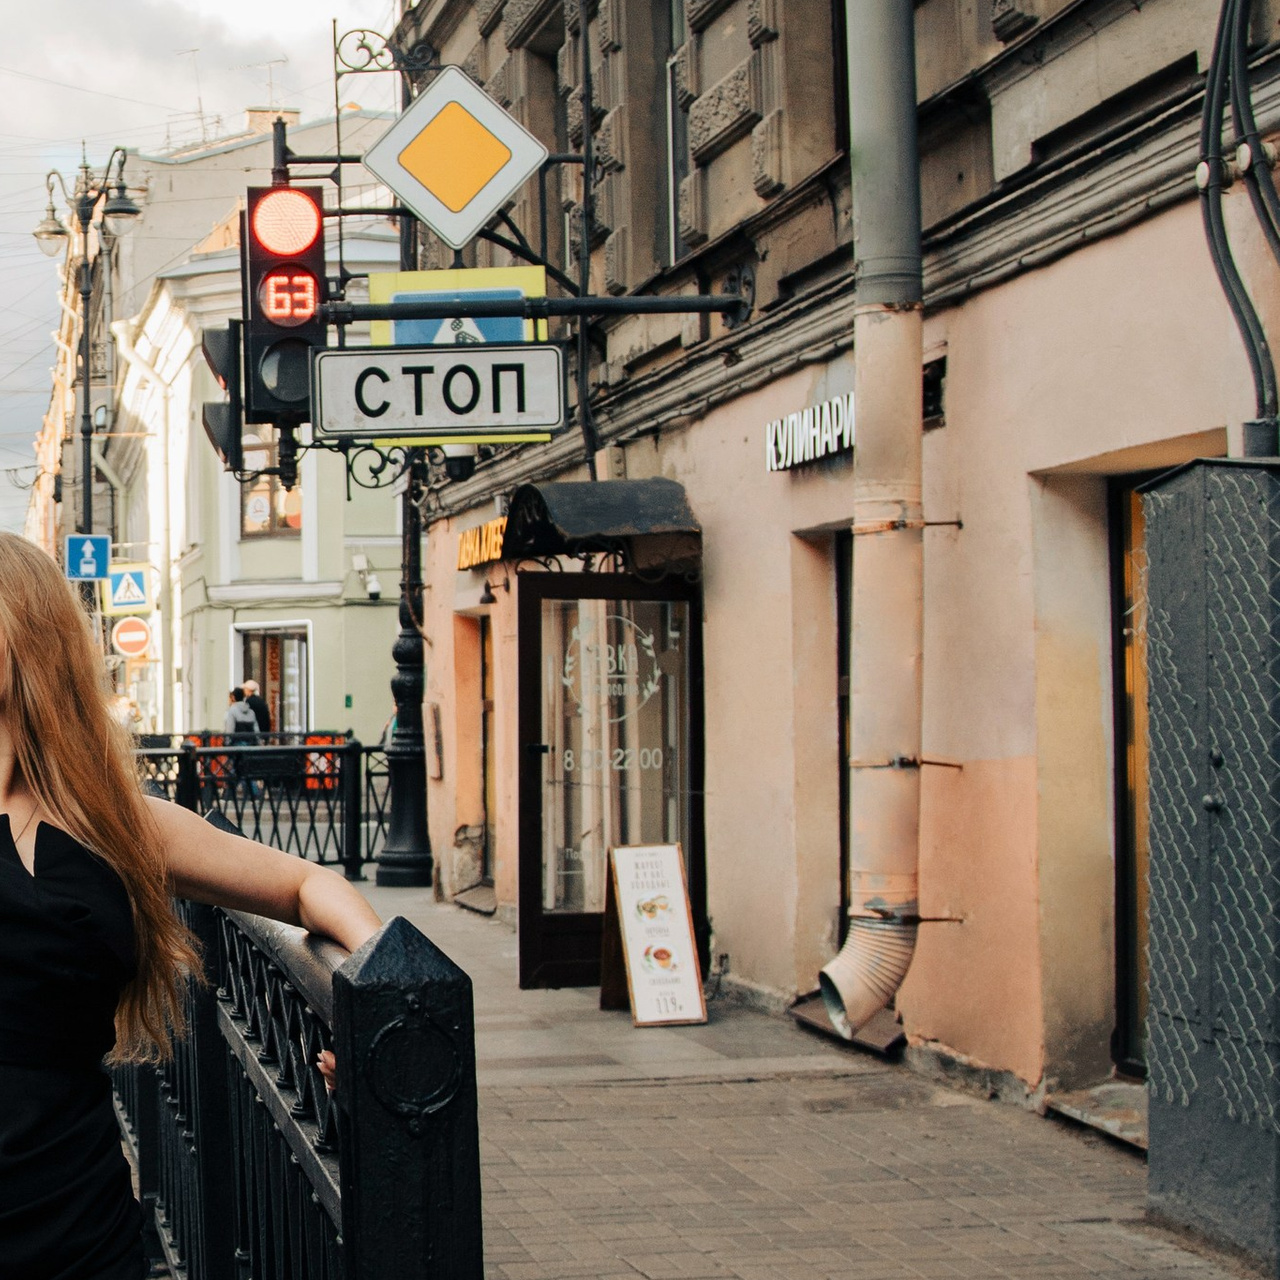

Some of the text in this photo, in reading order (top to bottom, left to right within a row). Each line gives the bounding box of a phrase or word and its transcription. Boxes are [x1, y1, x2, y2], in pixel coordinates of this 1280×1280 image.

[267, 275, 315, 318] 63
[354, 362, 527, 418] СТОП
[765, 390, 855, 473] КУЛИНАРИ
[480, 515, 508, 563] ХЛЕБ
